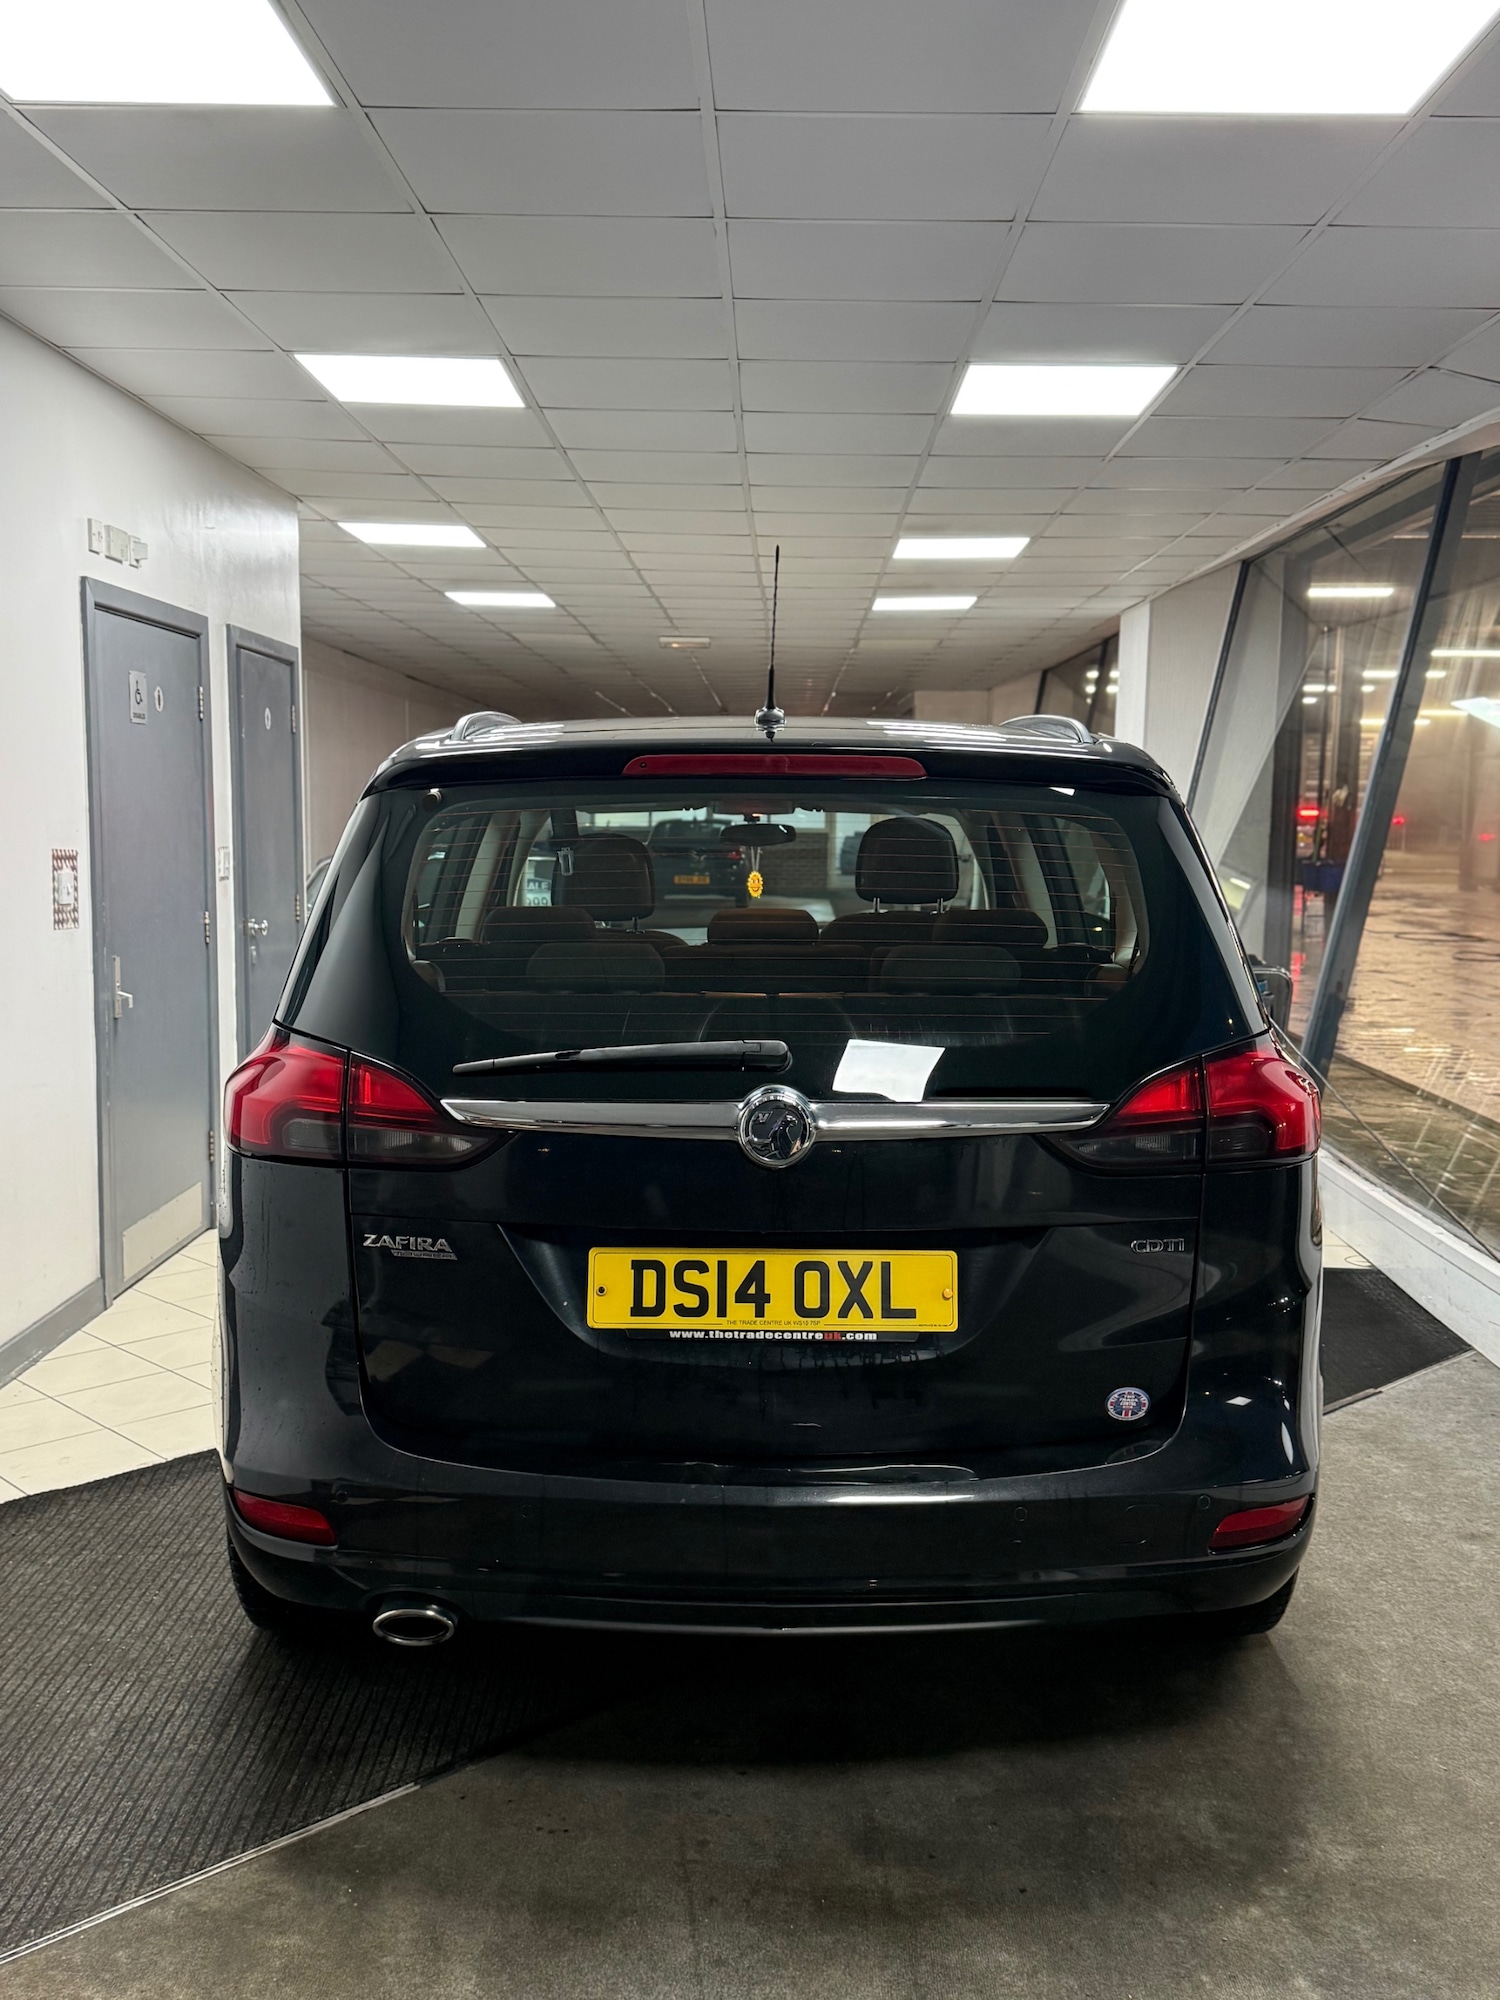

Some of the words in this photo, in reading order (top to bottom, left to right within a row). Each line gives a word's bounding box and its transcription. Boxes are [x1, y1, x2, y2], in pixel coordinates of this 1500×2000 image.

[363, 1234, 452, 1252] ZAFIRA
[630, 1259, 771, 1318] DS14
[794, 1261, 916, 1320] OXL
[669, 1330, 877, 1341] www.thetradecentreuk.com
